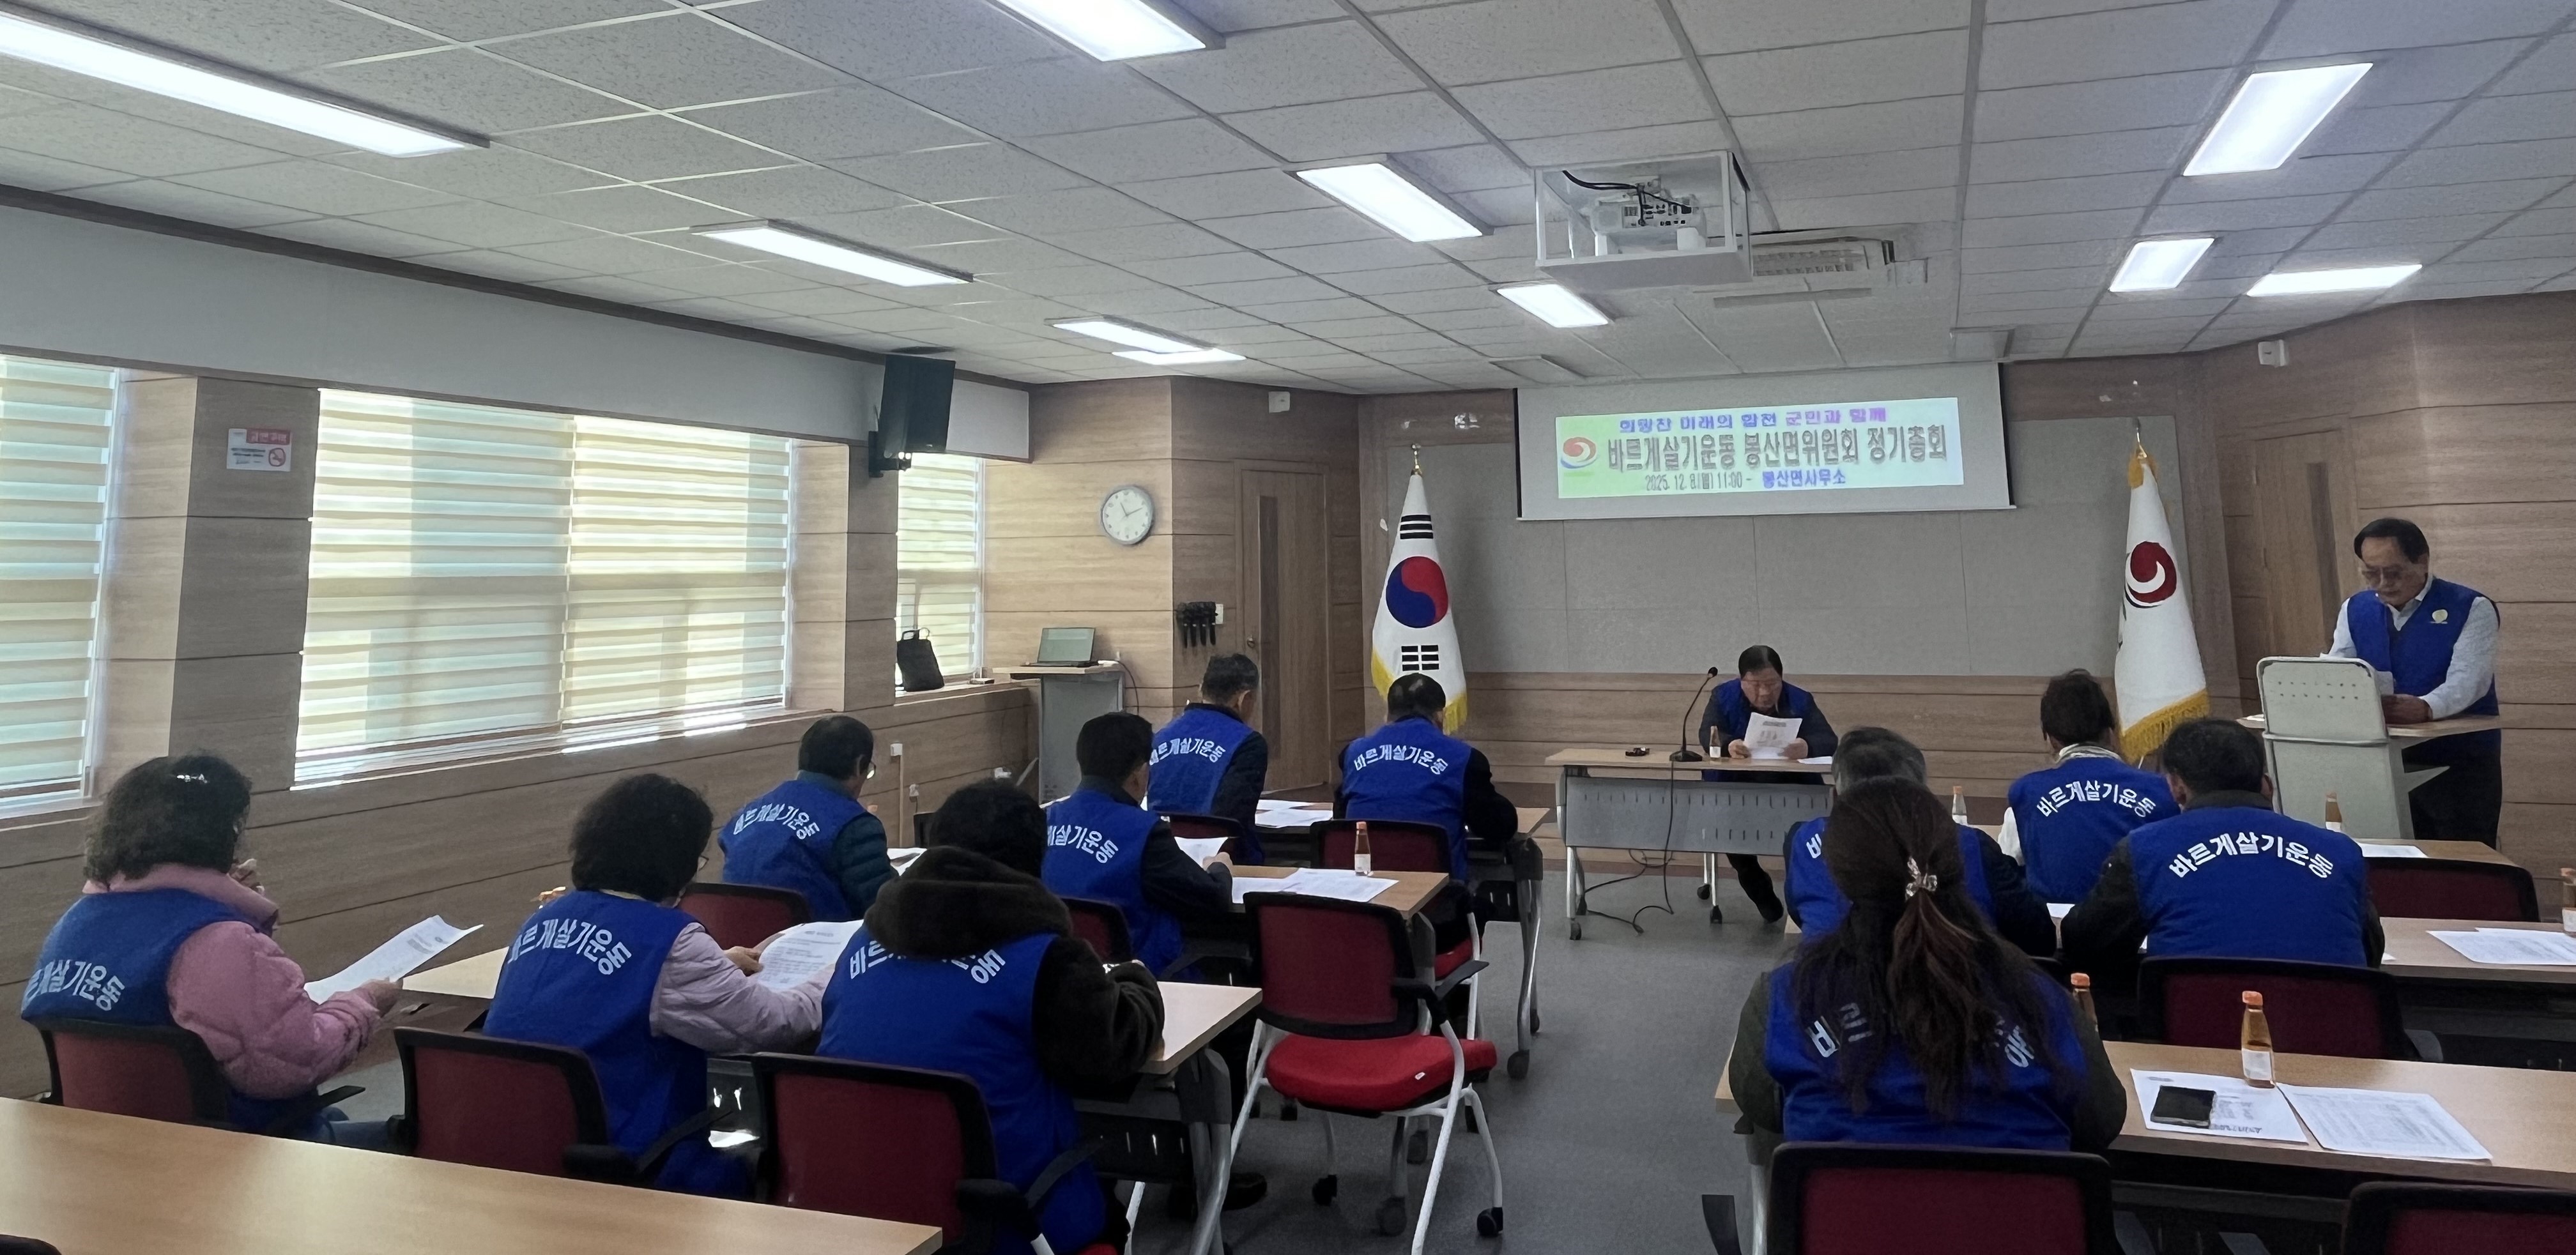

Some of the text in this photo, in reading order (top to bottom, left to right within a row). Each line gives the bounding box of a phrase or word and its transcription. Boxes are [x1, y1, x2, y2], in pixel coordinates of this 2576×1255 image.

[1620, 418, 1672, 434] 희망찬
[1680, 415, 1733, 430] 미래의
[1741, 413, 1777, 427] 합천
[1786, 410, 1841, 426] 군민과
[1608, 425, 1947, 473] 바르게살기운동 봉산면위원회 정기총회
[1762, 468, 1846, 489] 봉산면사무소
[1354, 745, 1448, 775] 바르게살기운동
[2037, 780, 2156, 818] 바르게살기운동
[733, 803, 820, 840] 바르게살기운동
[2169, 832, 2334, 878] 바르게살기운동
